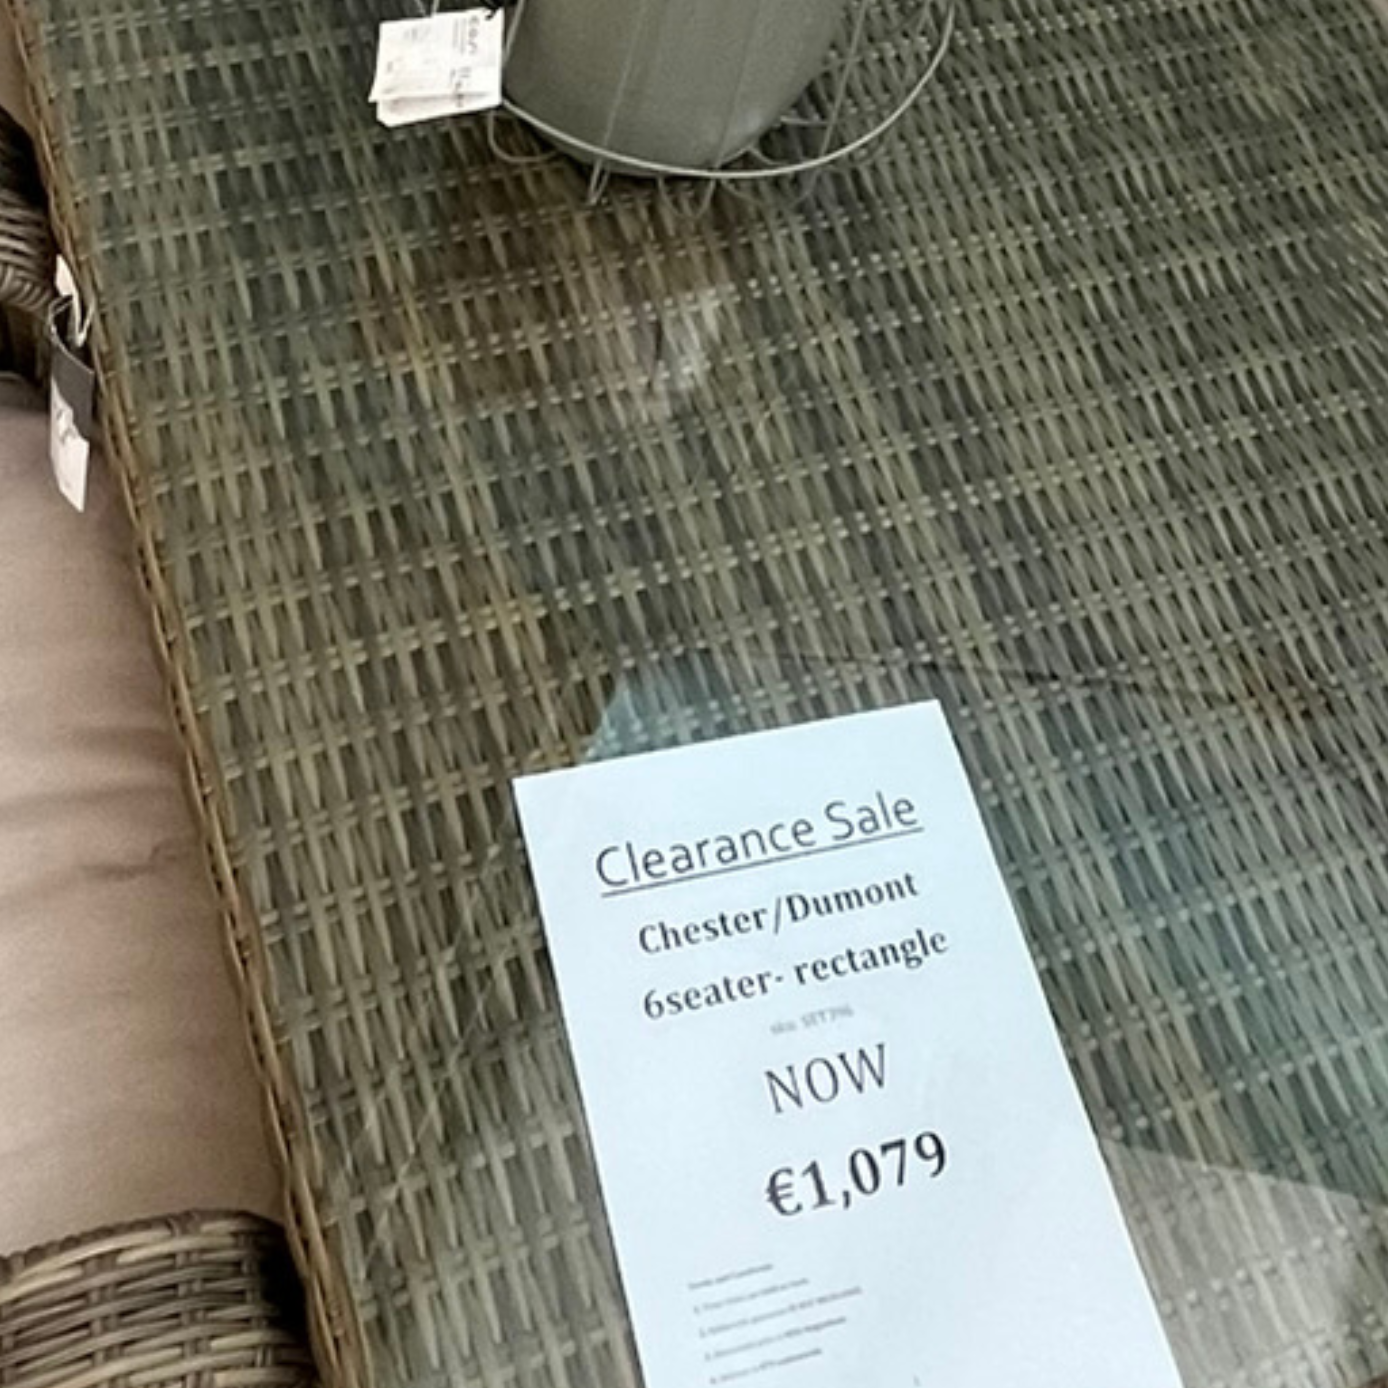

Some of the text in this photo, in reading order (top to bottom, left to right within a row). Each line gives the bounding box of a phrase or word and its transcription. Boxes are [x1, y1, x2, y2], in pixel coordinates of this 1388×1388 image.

[595, 790, 919, 888] Clearance Sale
[637, 871, 920, 955] Chester/Dumont
[642, 927, 950, 1021] 6seater- rectangle
[764, 1041, 886, 1114] NOW
[764, 1130, 947, 1217] €1,079
